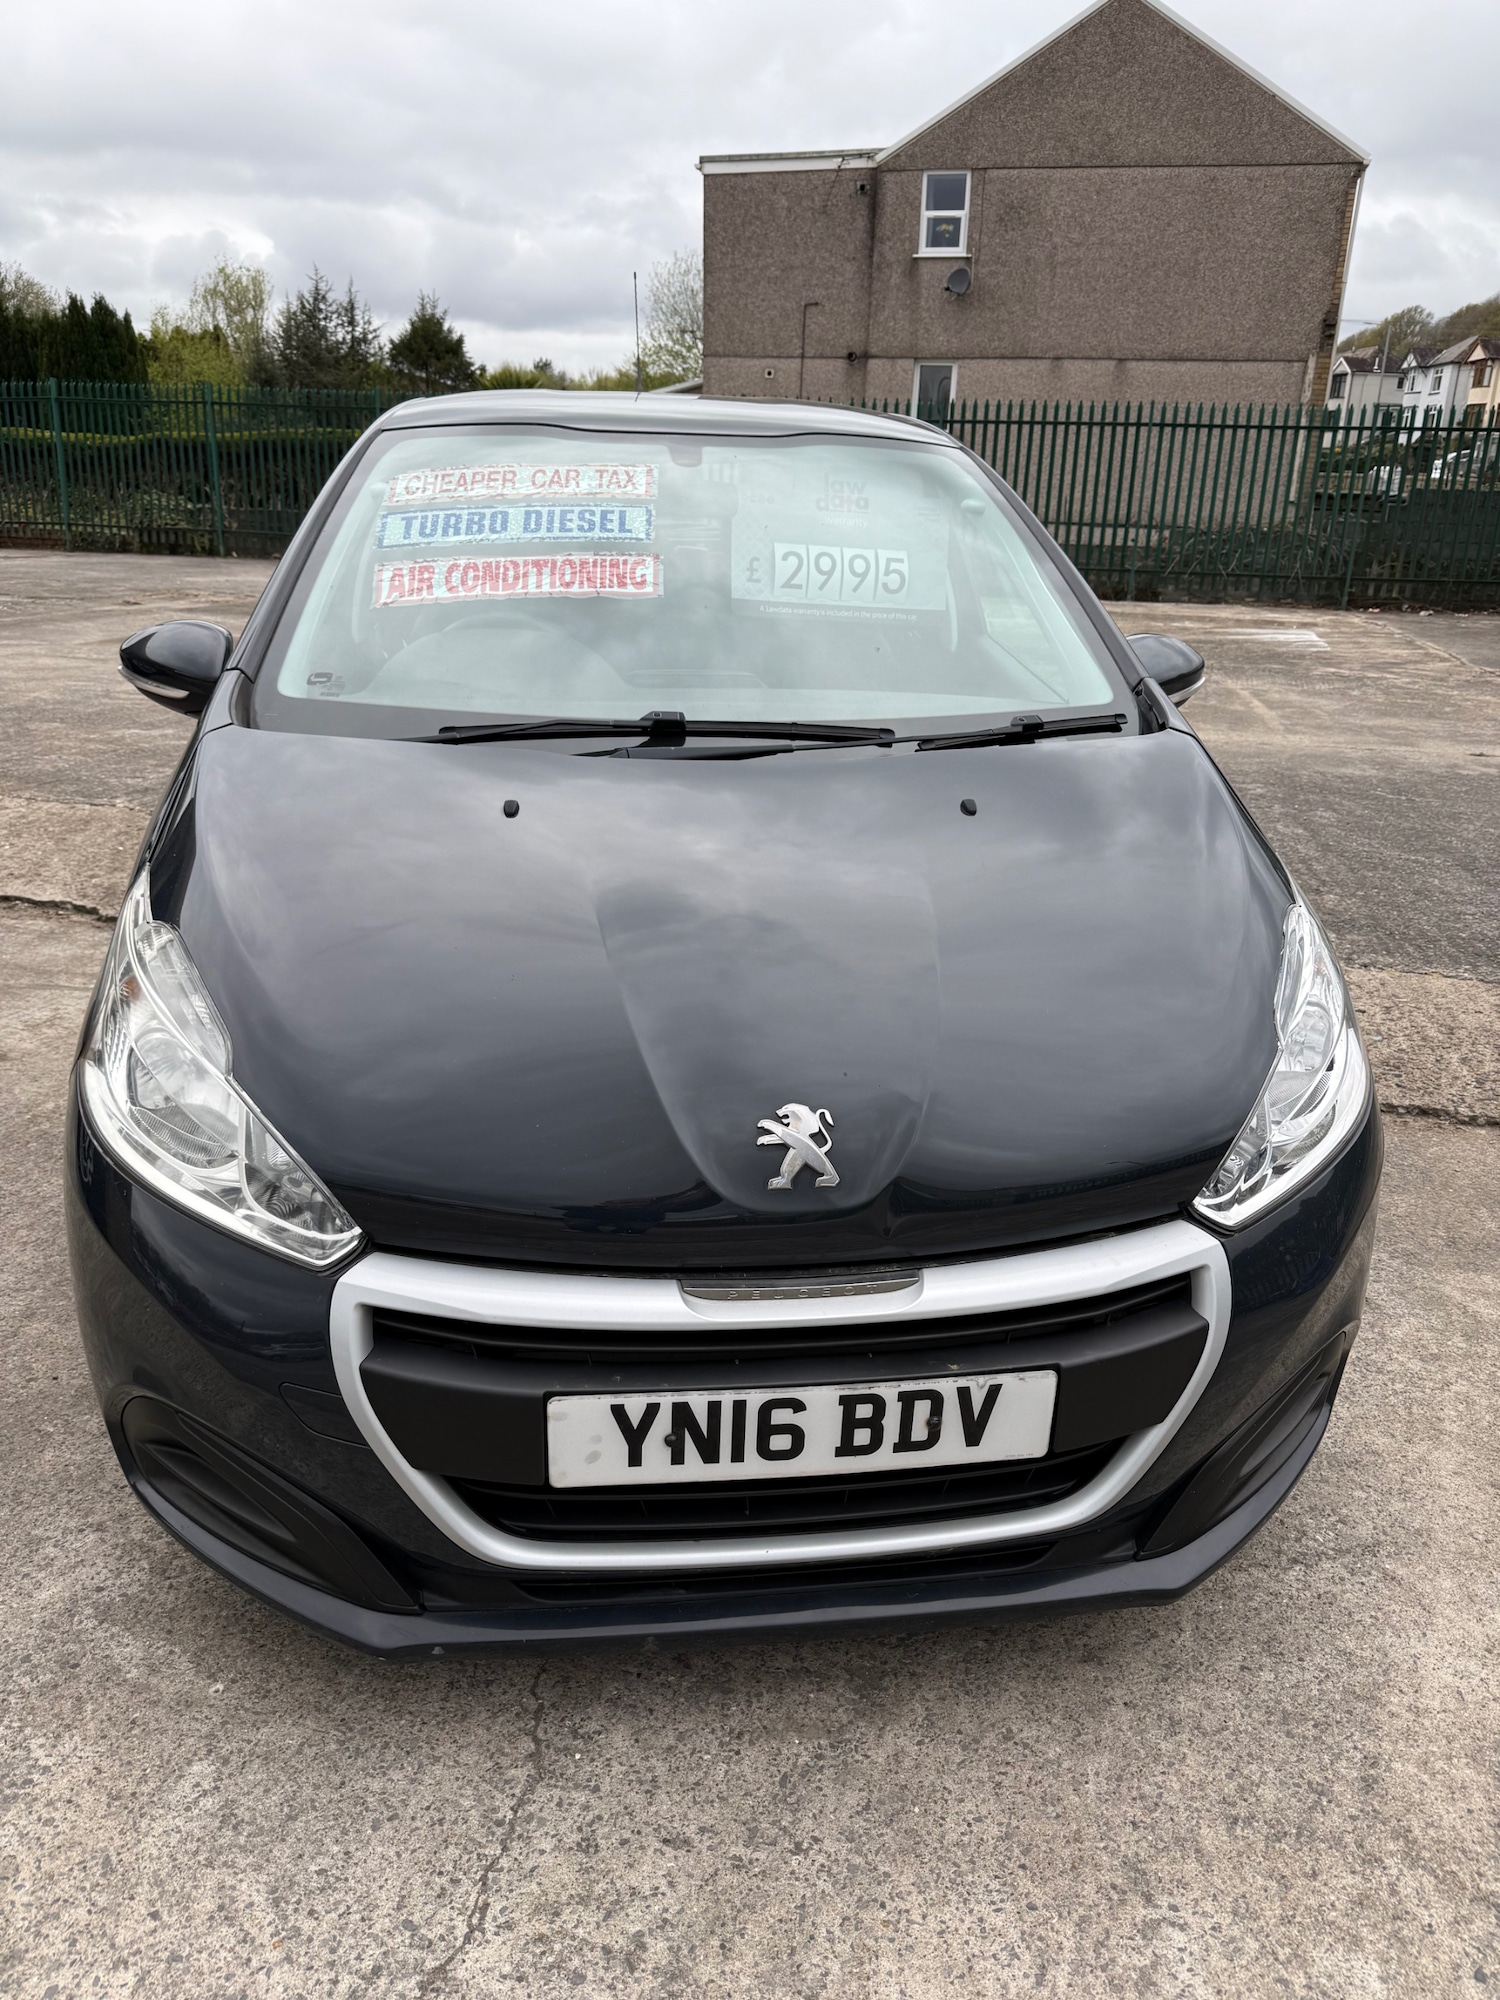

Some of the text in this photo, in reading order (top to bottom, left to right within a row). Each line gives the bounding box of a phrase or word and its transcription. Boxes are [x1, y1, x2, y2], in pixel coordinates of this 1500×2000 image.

[404, 468, 638, 496] CHEAPER CAR TAX
[824, 473, 867, 494] law
[815, 493, 870, 513] data
[400, 509, 633, 541] TURBO DIESEL
[386, 557, 648, 600] AIR CONDITIONING
[779, 550, 907, 595] 2995
[759, 604, 765, 612] A
[766, 605, 792, 614] Lawdata
[793, 607, 820, 617] warranty
[826, 609, 853, 617] included
[861, 610, 871, 618] the
[872, 611, 887, 620] price
[888, 611, 895, 619] of
[895, 611, 906, 620] this
[728, 1284, 878, 1300] PEUGEOT
[610, 1383, 1003, 1467] YN16 BDV
